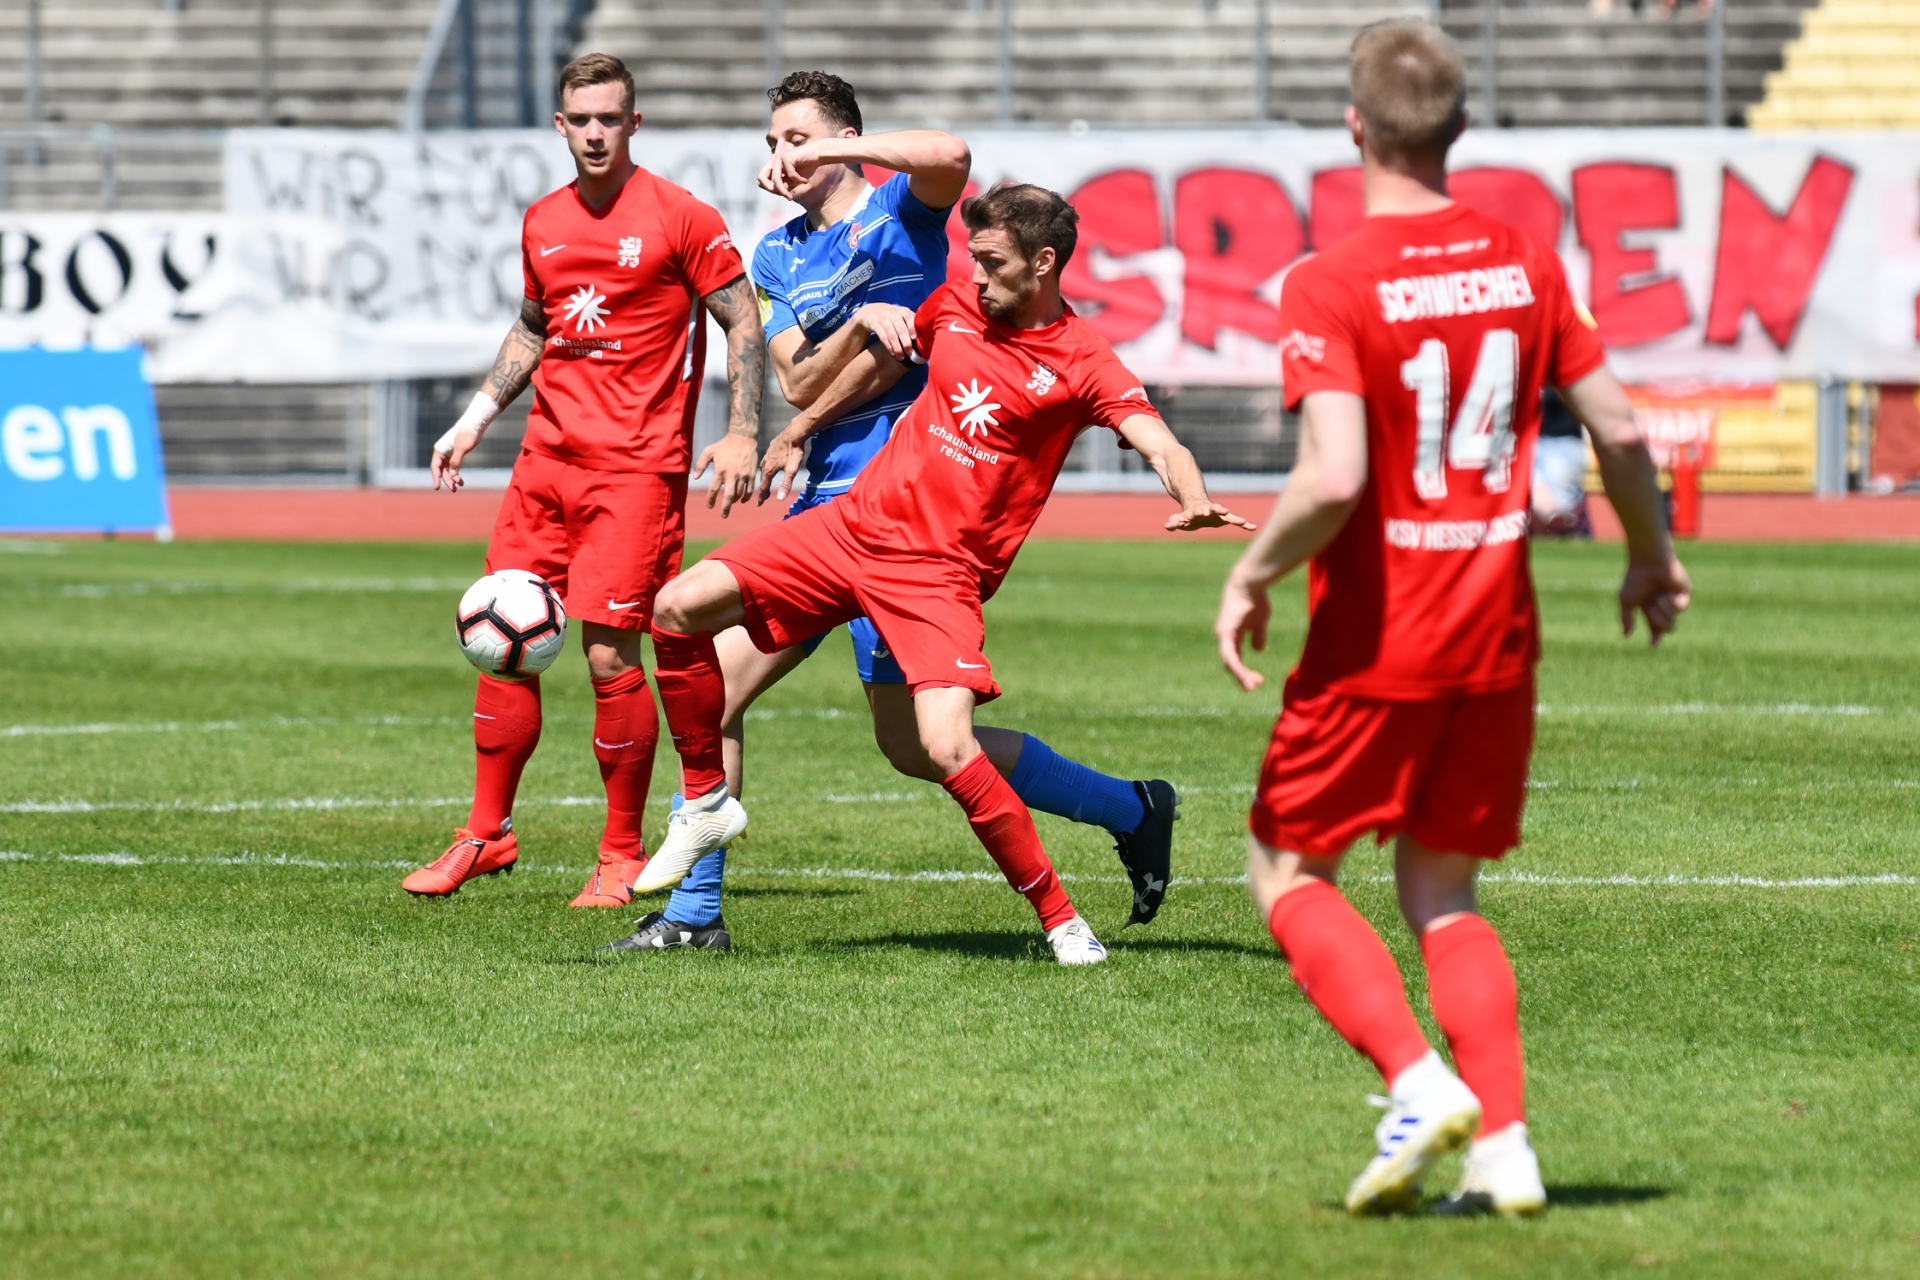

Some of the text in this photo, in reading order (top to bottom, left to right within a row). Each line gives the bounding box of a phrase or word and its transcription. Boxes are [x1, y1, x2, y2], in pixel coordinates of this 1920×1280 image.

[1376, 264, 1535, 324] SCHWECHEL
[551, 336, 622, 351] schauinsland
[569, 345, 603, 359] reisen
[1399, 327, 1520, 500] 14
[1, 403, 137, 482] en
[927, 423, 999, 466] schauinsland
[939, 443, 976, 470] reisen
